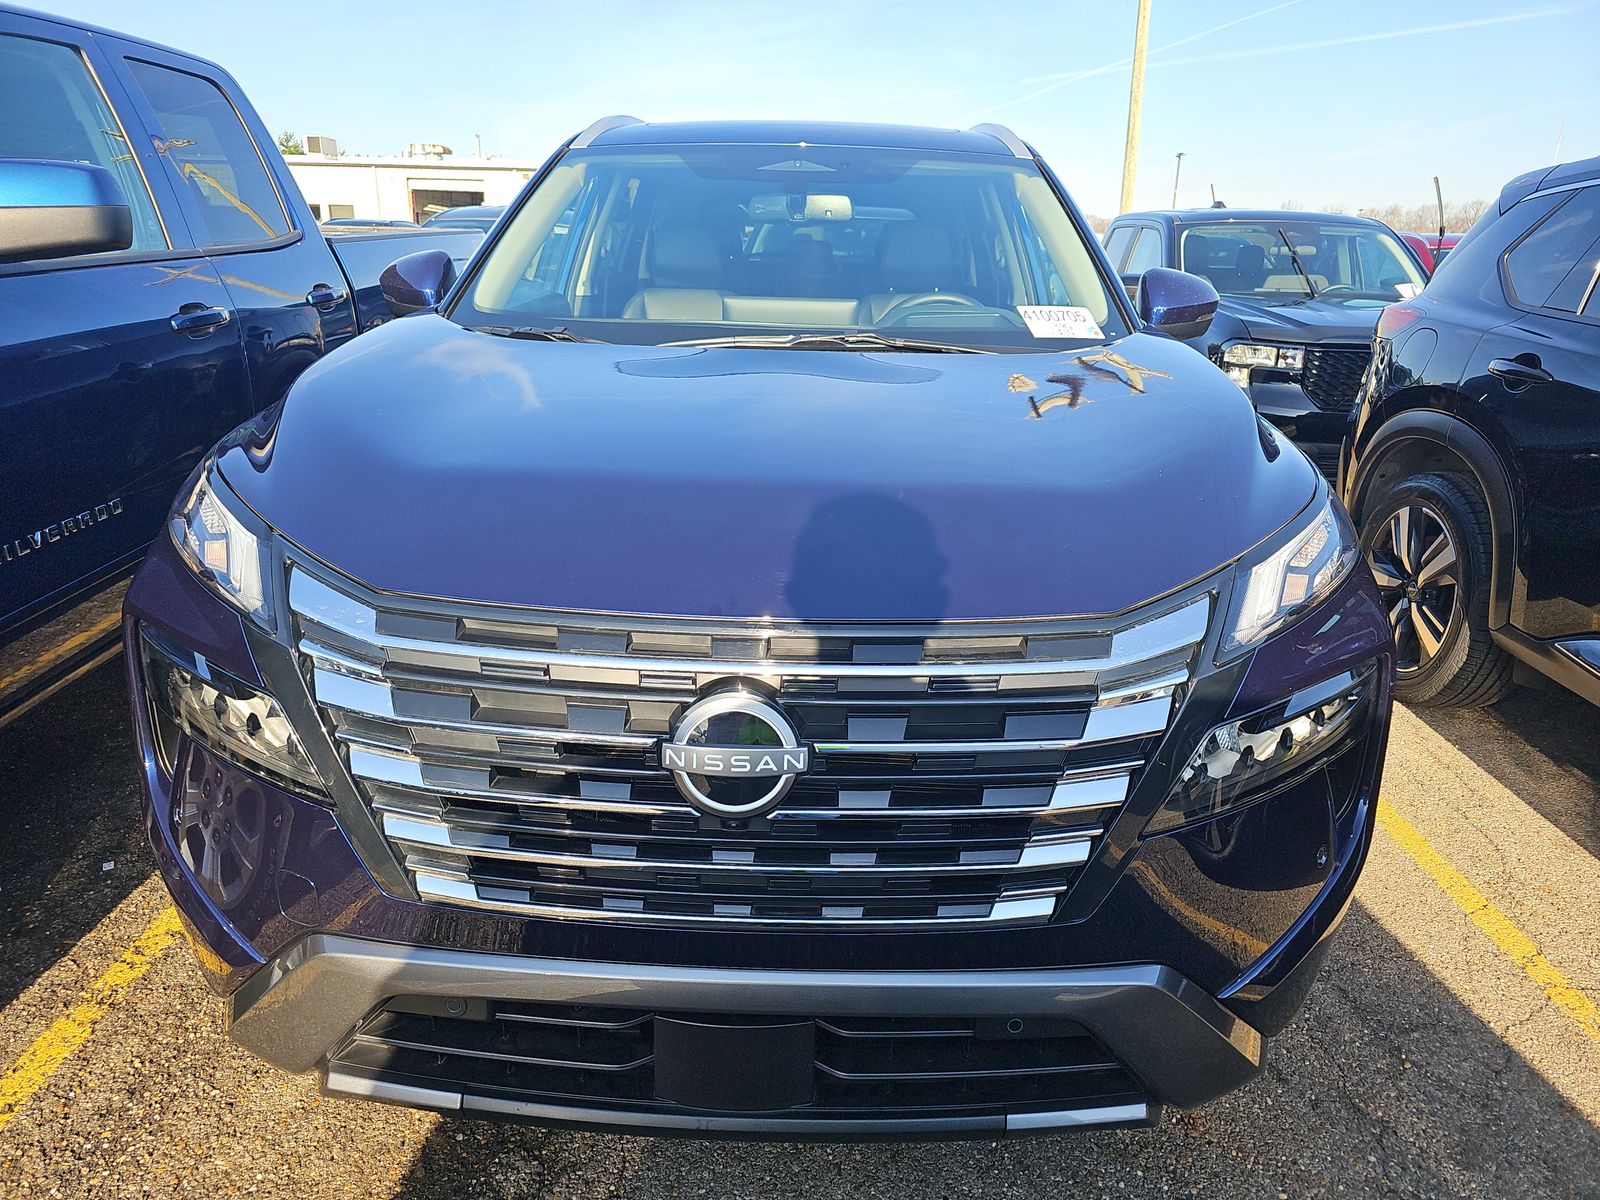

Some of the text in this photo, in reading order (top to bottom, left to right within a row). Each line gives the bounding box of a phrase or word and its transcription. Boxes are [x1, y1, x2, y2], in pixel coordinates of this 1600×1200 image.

[1023, 309, 1086, 322] 4100705
[0, 498, 123, 565] ILVERADO
[665, 748, 804, 772] NISSAN
